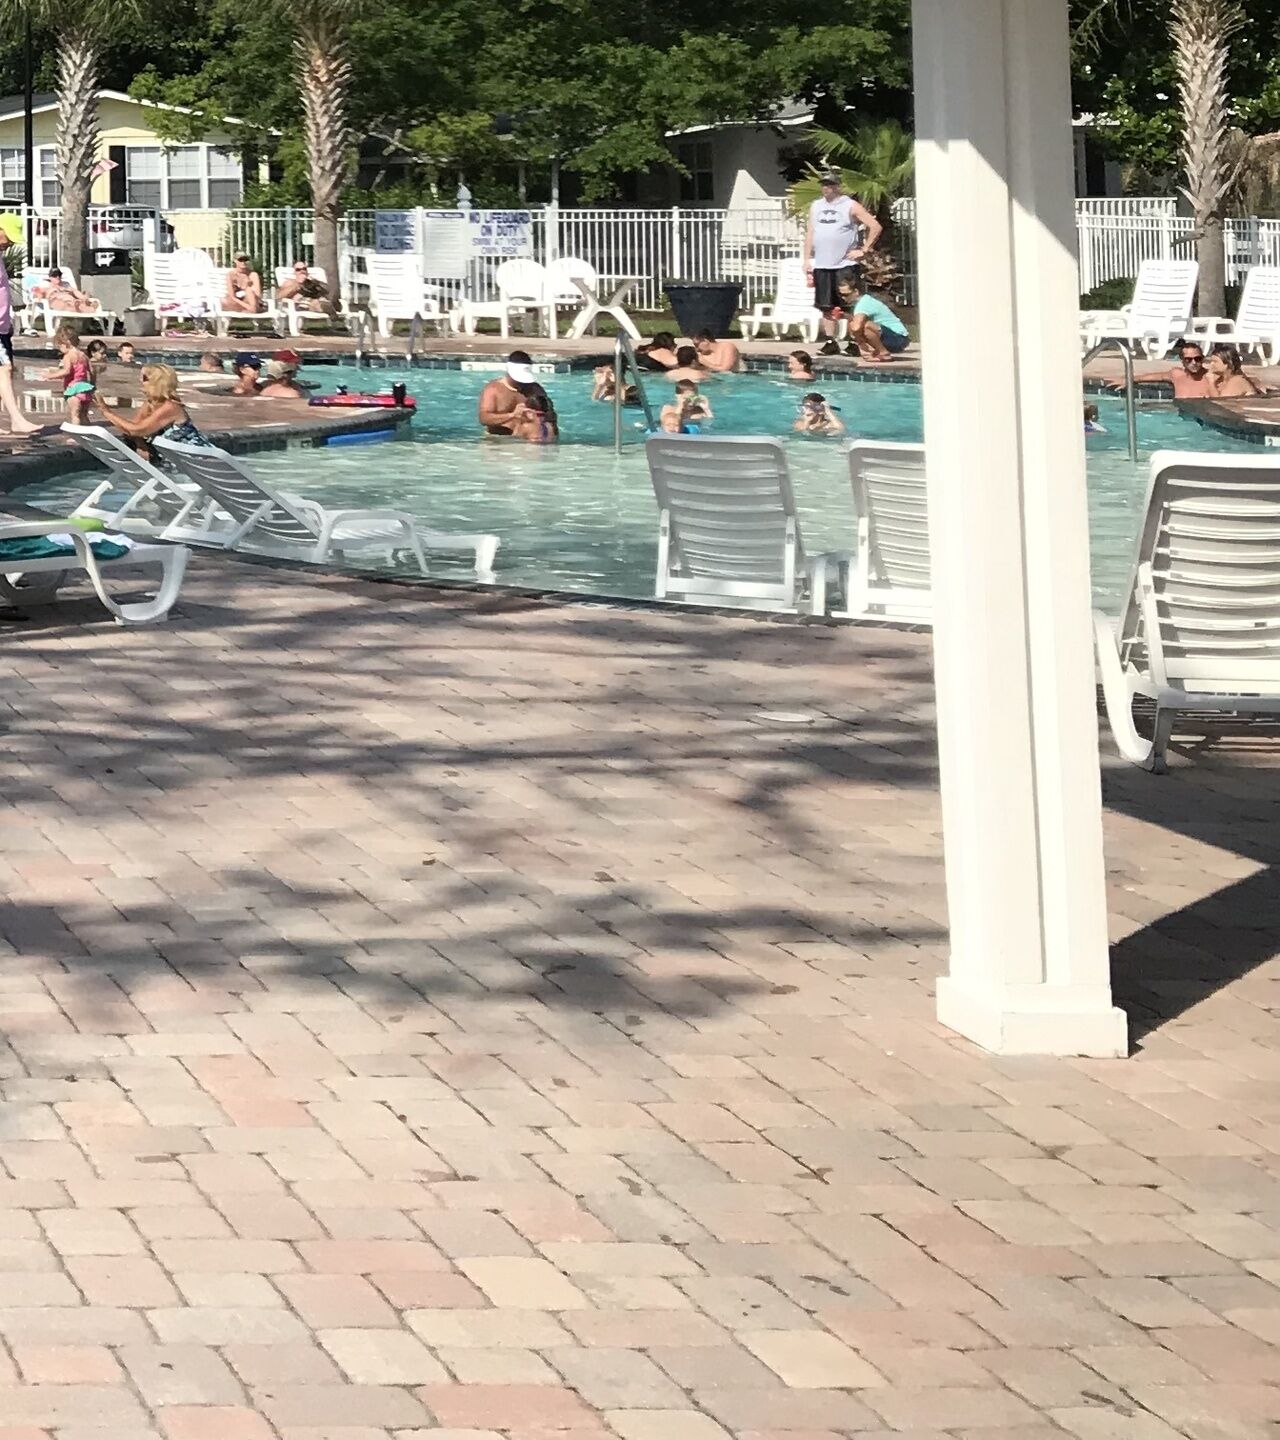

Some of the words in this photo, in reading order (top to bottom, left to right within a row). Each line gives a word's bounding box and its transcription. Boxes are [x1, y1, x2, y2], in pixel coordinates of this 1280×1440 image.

[469, 212, 480, 224] NO
[484, 212, 531, 224] LIFEGUARD
[481, 225, 492, 236] ON
[496, 225, 519, 236] DUTY
[472, 237, 491, 246] SWIM
[495, 237, 505, 246] AT
[506, 237, 527, 246] YOUR
[481, 247, 498, 255] OWN
[501, 247, 518, 255] RISK
